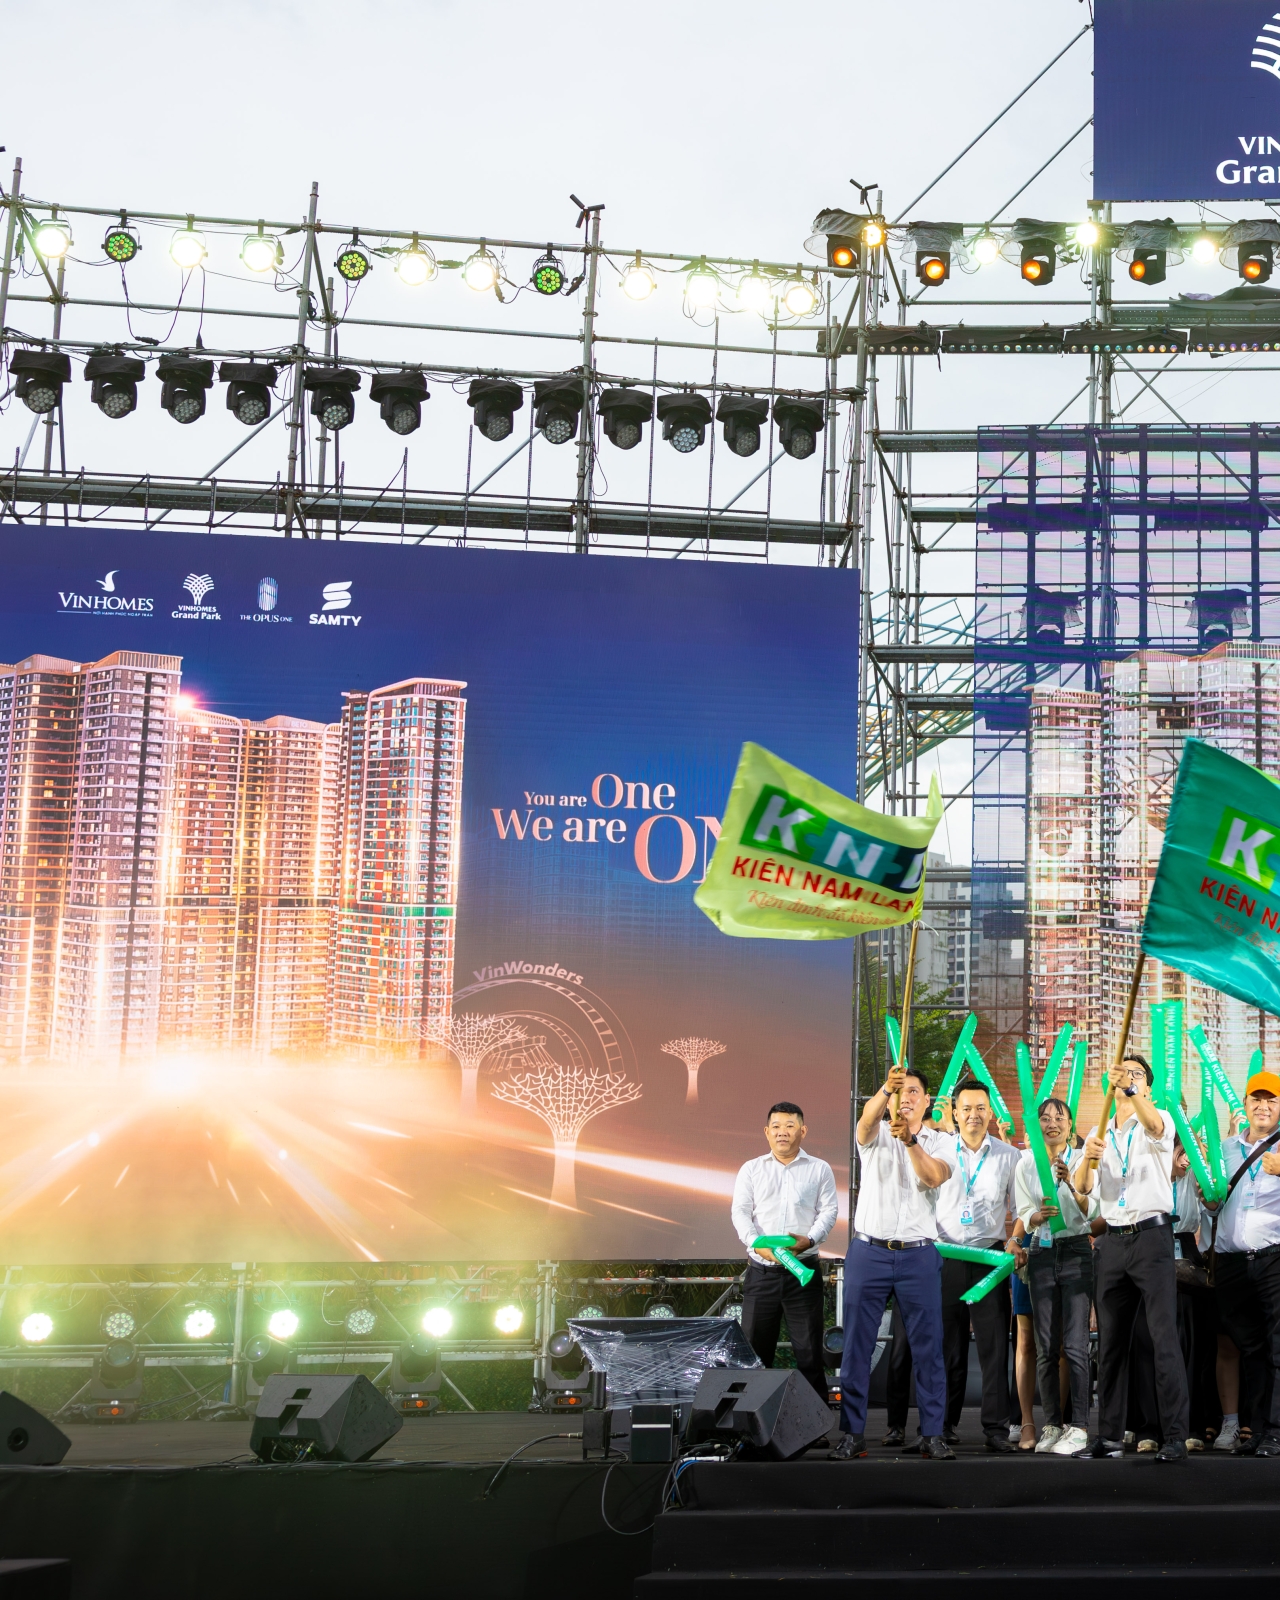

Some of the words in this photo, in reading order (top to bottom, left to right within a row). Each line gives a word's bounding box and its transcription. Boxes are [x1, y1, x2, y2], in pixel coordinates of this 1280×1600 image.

[58, 592, 154, 611] VINHOMES
[178, 605, 217, 613] VINHOMES
[171, 611, 199, 620] Grand
[201, 612, 221, 621] Park
[253, 614, 280, 623] OPUS
[309, 613, 362, 627] SAMTY
[524, 791, 555, 807] You
[558, 794, 588, 807] are
[591, 773, 676, 811] One
[490, 808, 554, 842] We
[562, 817, 627, 844] are
[731, 855, 795, 887] KIÊN
[801, 870, 864, 902] NAM
[869, 891, 917, 913] LAN
[1200, 875, 1257, 918] KIÊN
[473, 960, 584, 985] VinWonders
[1222, 1083, 1237, 1102] NAM
